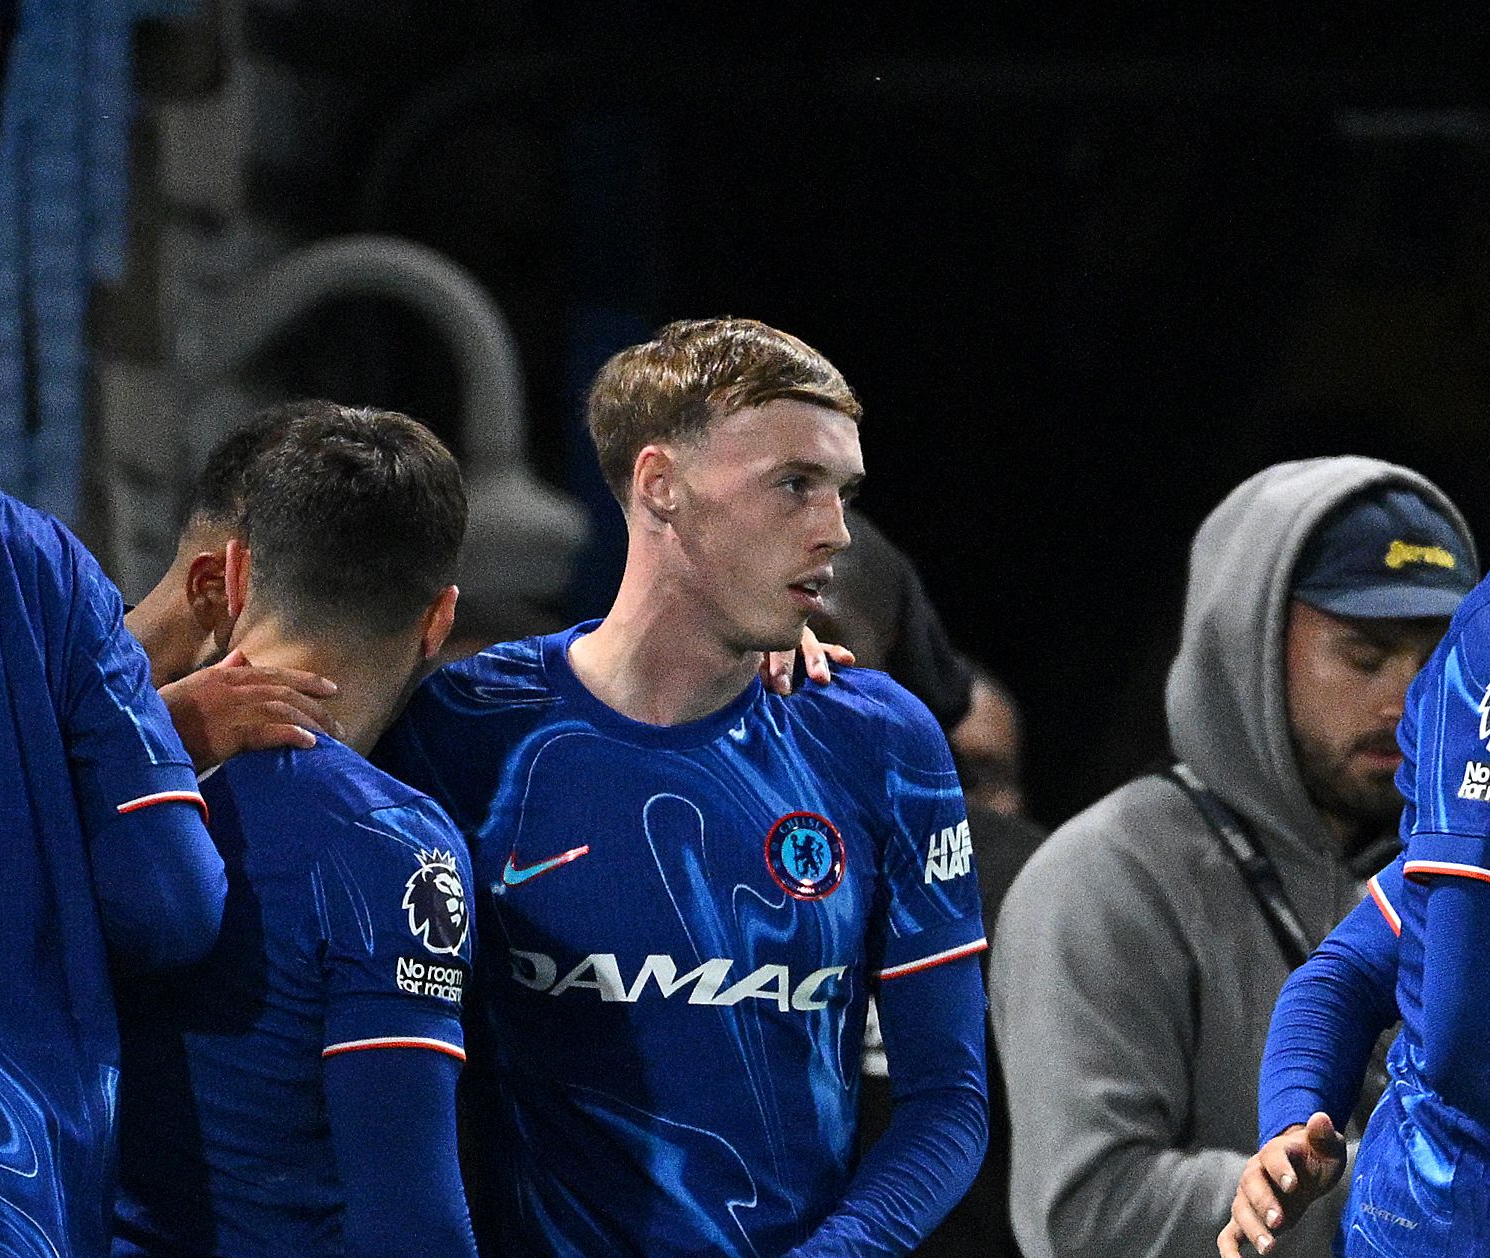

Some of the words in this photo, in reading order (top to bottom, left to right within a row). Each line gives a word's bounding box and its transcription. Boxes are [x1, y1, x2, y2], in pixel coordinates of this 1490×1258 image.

[1464, 761, 1490, 783] No
[929, 819, 972, 859] LIVE
[396, 956, 425, 979] No
[427, 965, 463, 986] room
[396, 974, 422, 995] for
[509, 948, 847, 1012] DAMAC
